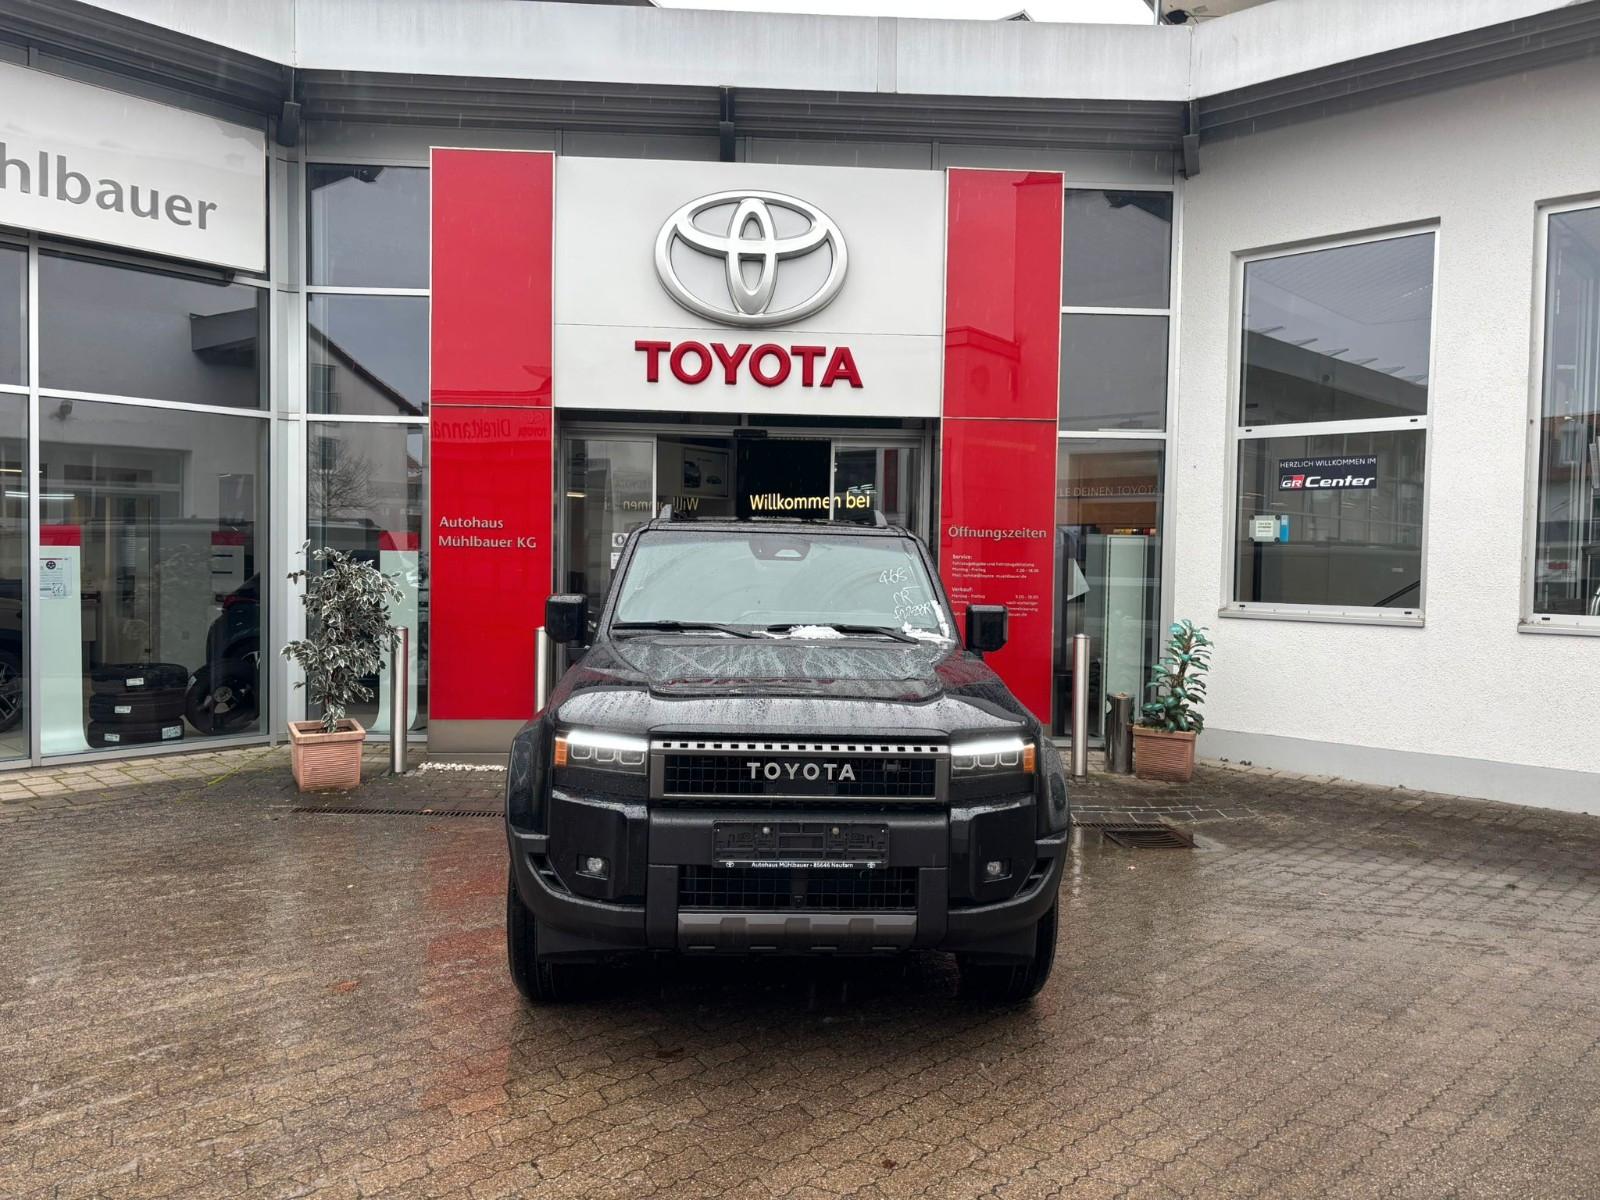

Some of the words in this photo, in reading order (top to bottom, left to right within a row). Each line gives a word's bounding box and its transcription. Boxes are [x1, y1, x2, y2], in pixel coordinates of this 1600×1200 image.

[0, 141, 219, 230] hlbauer
[634, 340, 864, 389] TOYOTA
[1280, 460, 1314, 468] HERZLICH
[1315, 458, 1366, 468] WILLKOMMEN
[1366, 457, 1377, 465] IM
[1281, 479, 1304, 488] GR
[1304, 475, 1376, 488] Center
[750, 492, 842, 510] Willkommen
[845, 491, 871, 509] bei
[439, 516, 504, 529] Autohaus
[948, 524, 1047, 541] Öffnungszeiten
[438, 535, 513, 548] Mühlbauer
[517, 537, 537, 549] KG
[746, 762, 856, 781] TOYOTA
